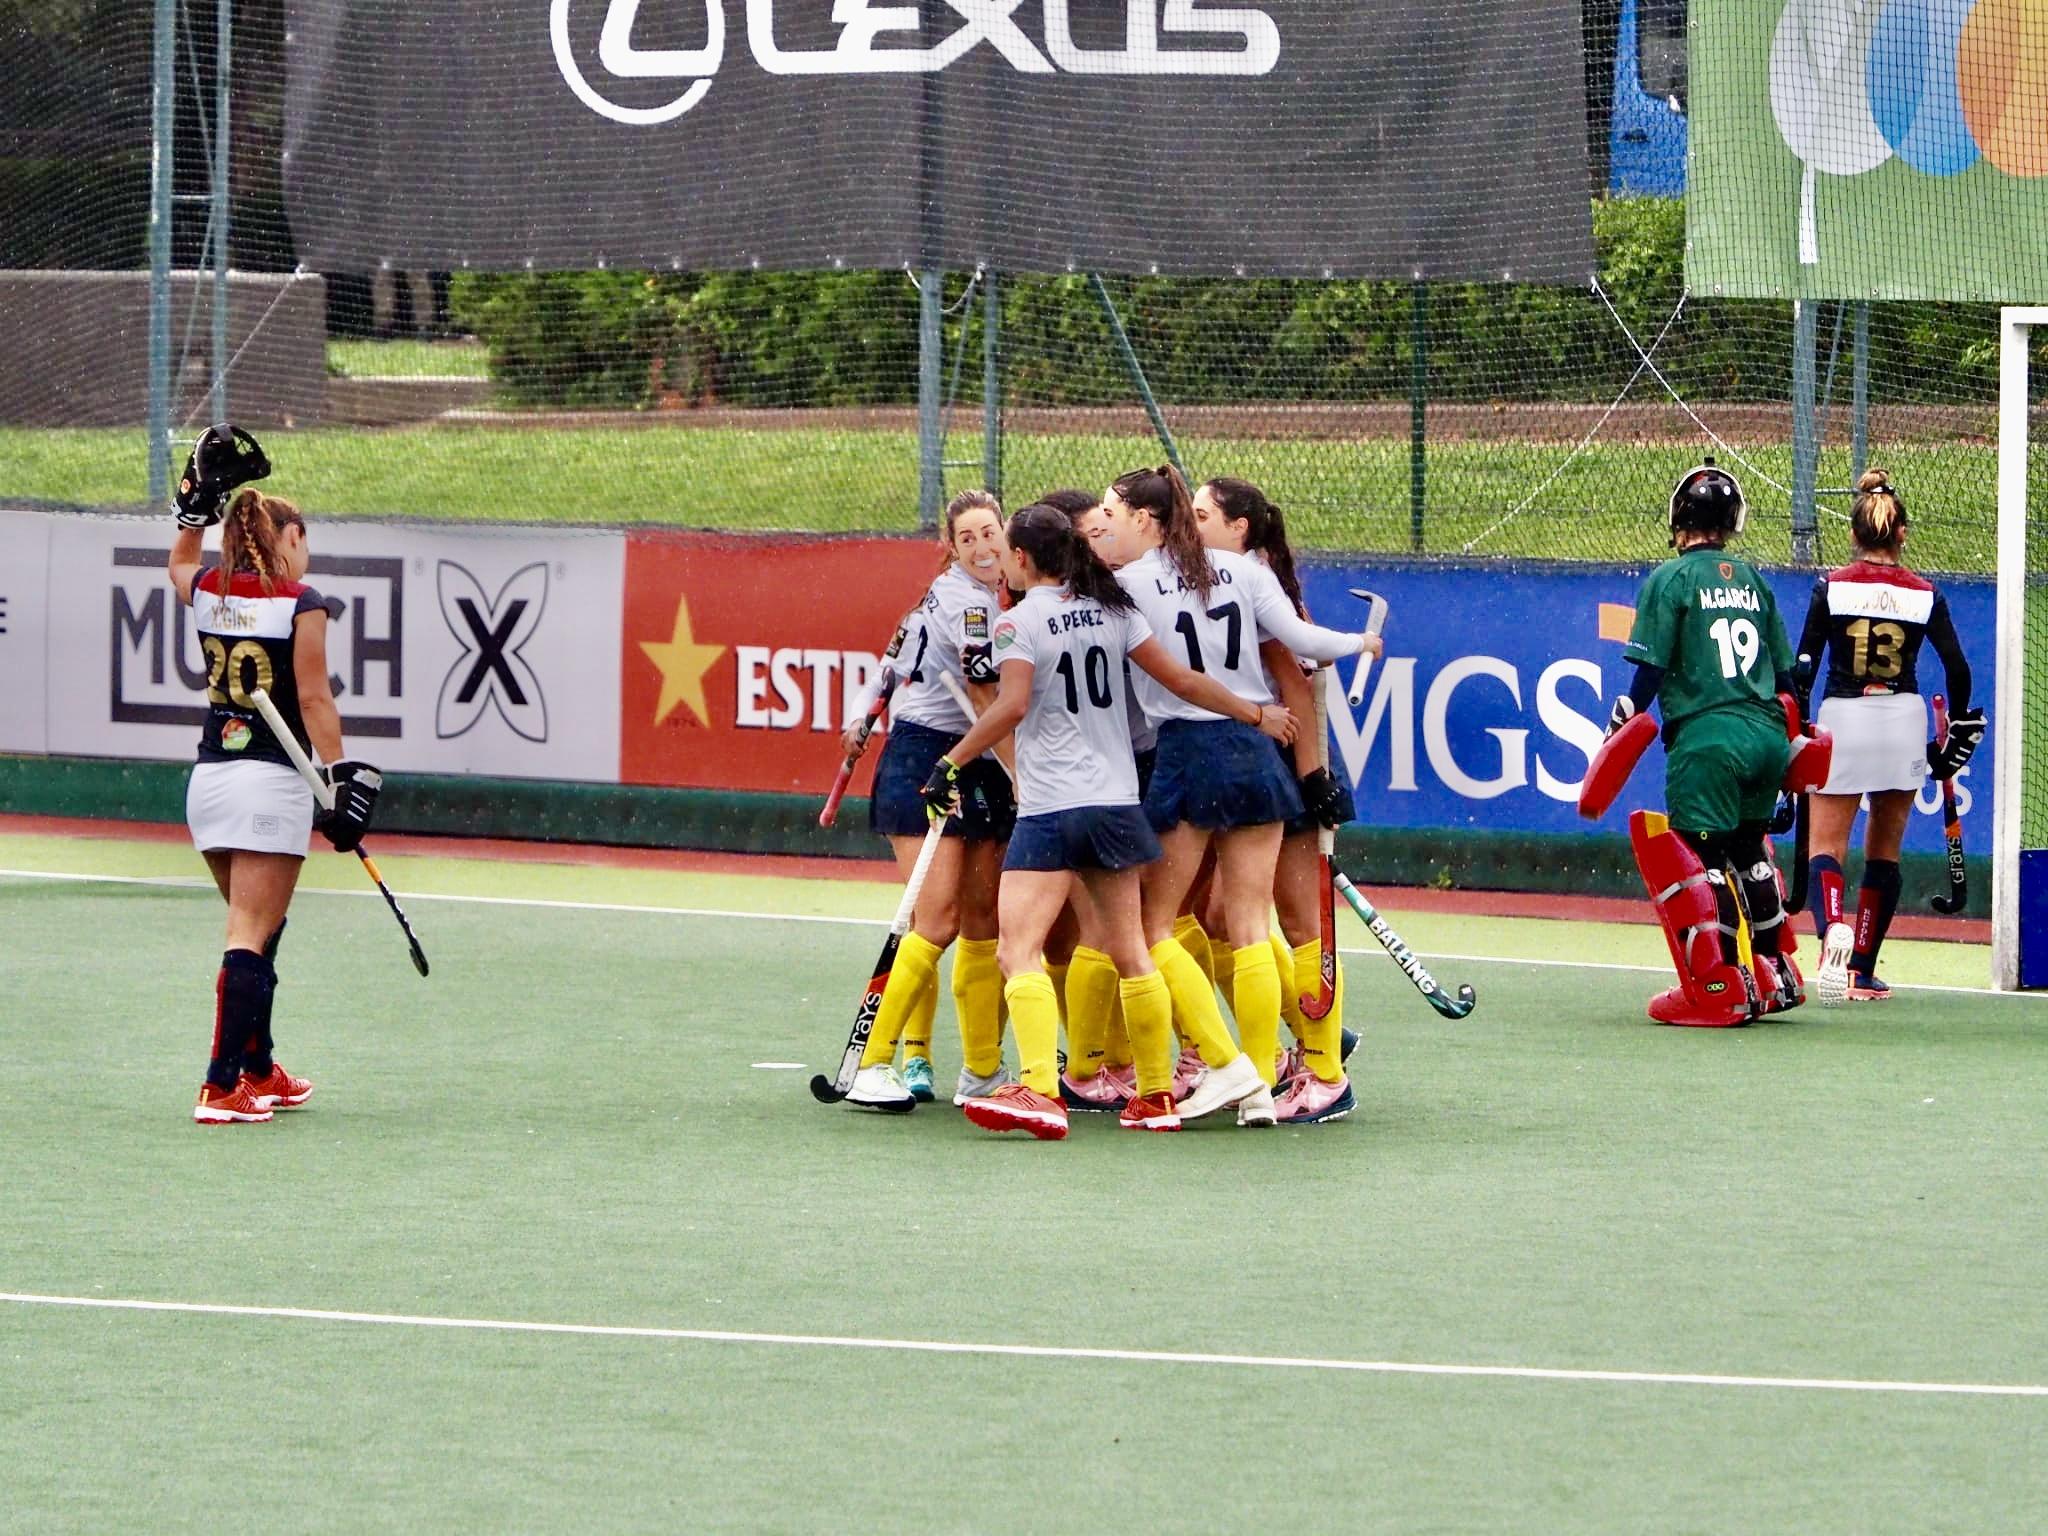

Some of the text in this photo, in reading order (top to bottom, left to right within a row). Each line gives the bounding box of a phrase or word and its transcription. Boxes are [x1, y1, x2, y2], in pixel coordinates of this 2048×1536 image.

[202, 636, 273, 708] 20
[1174, 600, 1242, 674] 17
[1708, 616, 1760, 679] 19
[1845, 617, 1906, 679] 13
[736, 645, 893, 733] ESTR
[1056, 644, 1113, 715] 10
[1325, 655, 1612, 802] MGS
[1368, 914, 1437, 995] BALLING
